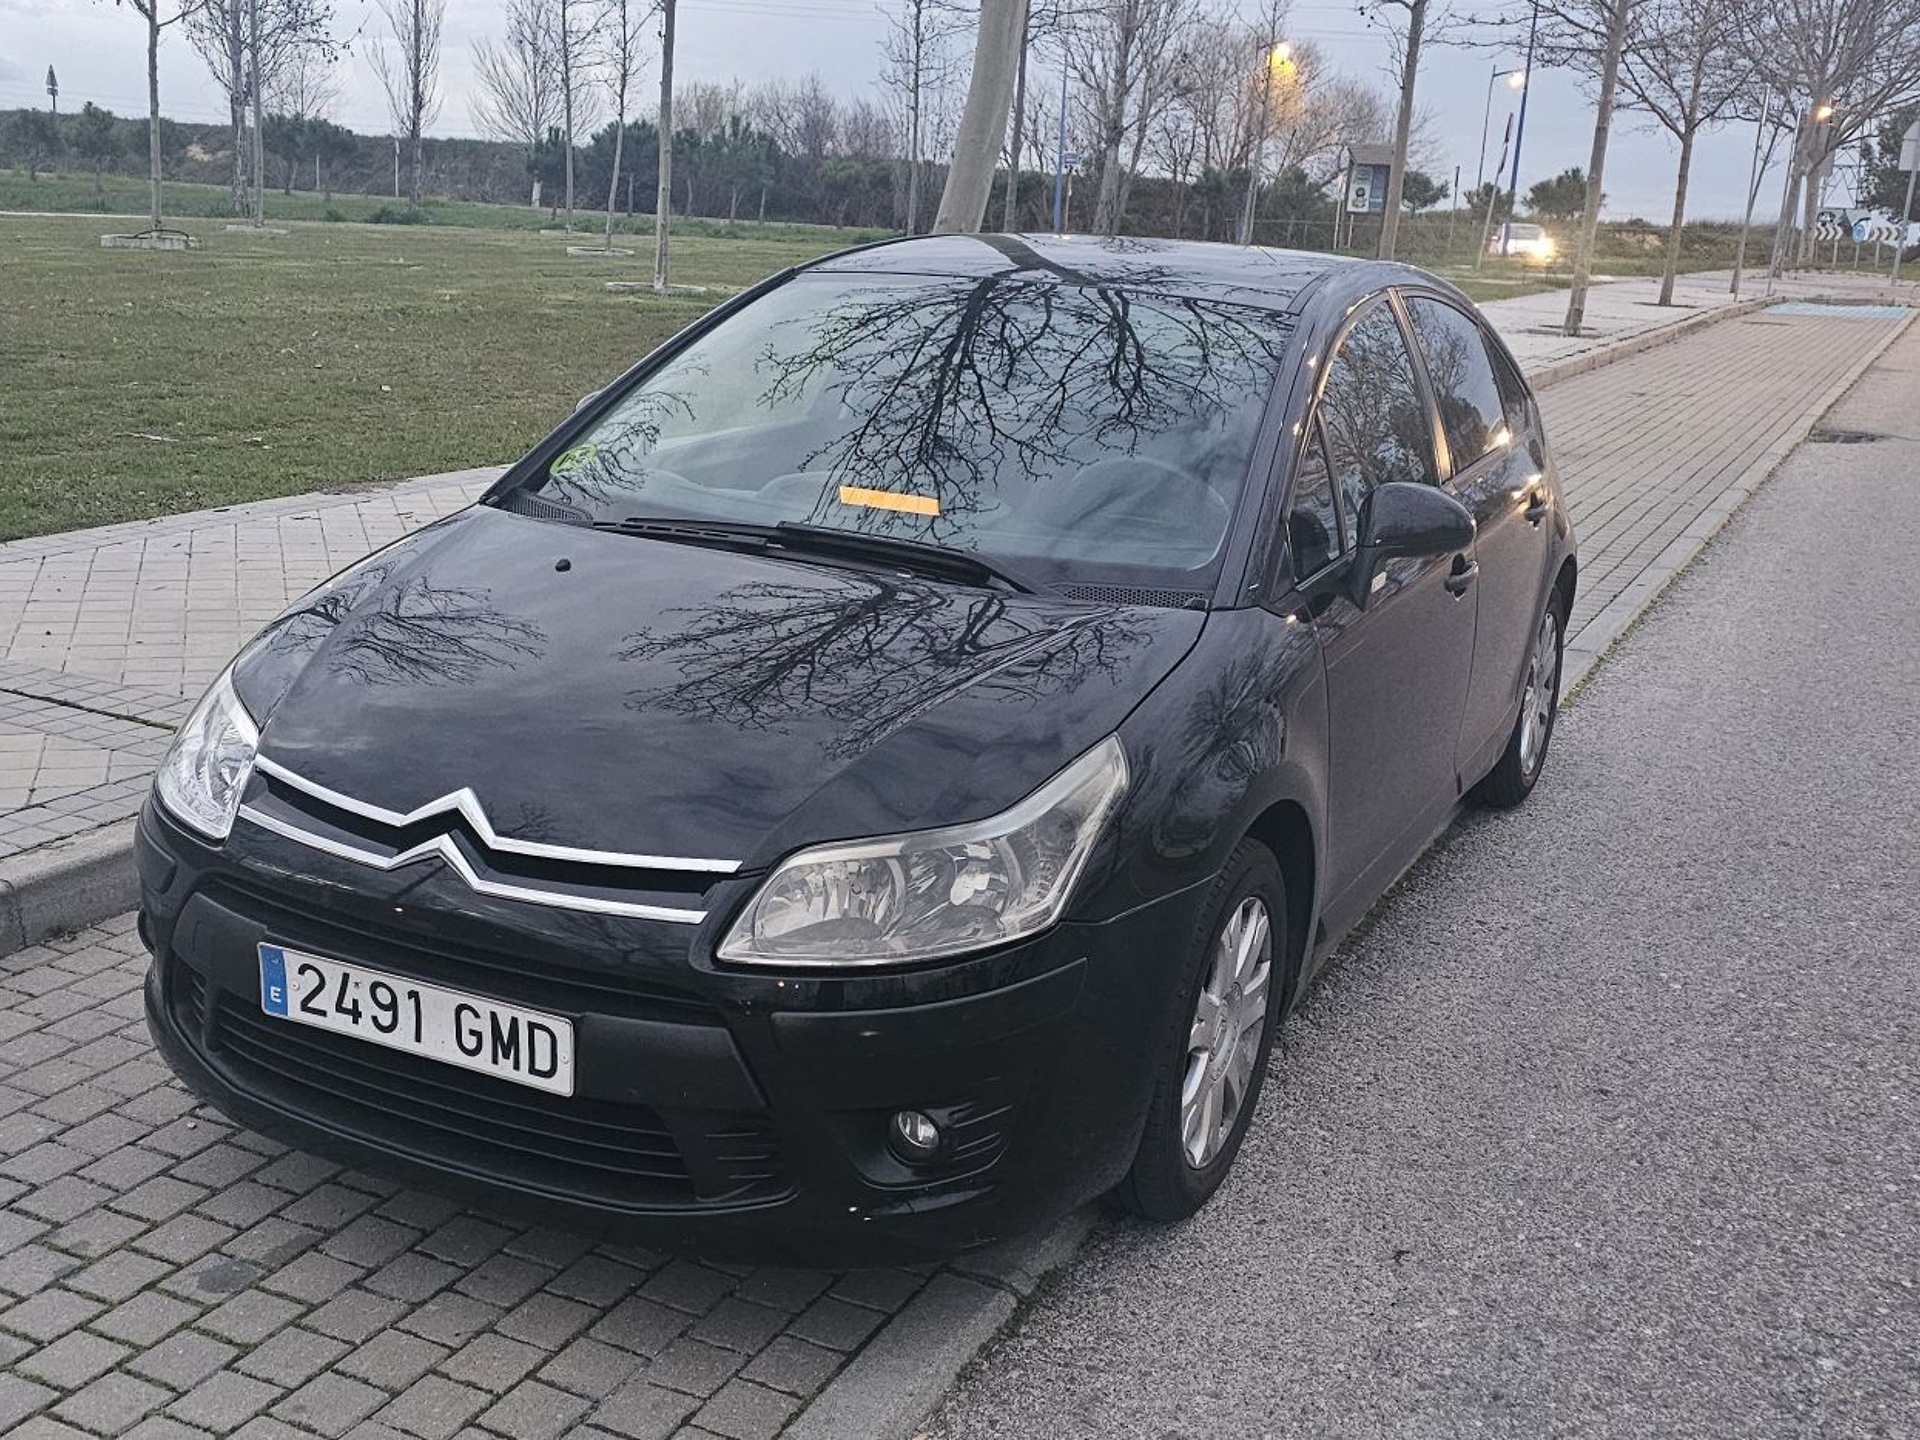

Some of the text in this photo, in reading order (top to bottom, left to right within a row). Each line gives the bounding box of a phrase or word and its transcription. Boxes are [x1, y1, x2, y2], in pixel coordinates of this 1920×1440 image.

[270, 986, 282, 1003] E
[298, 963, 557, 1079] 2491 GMD
